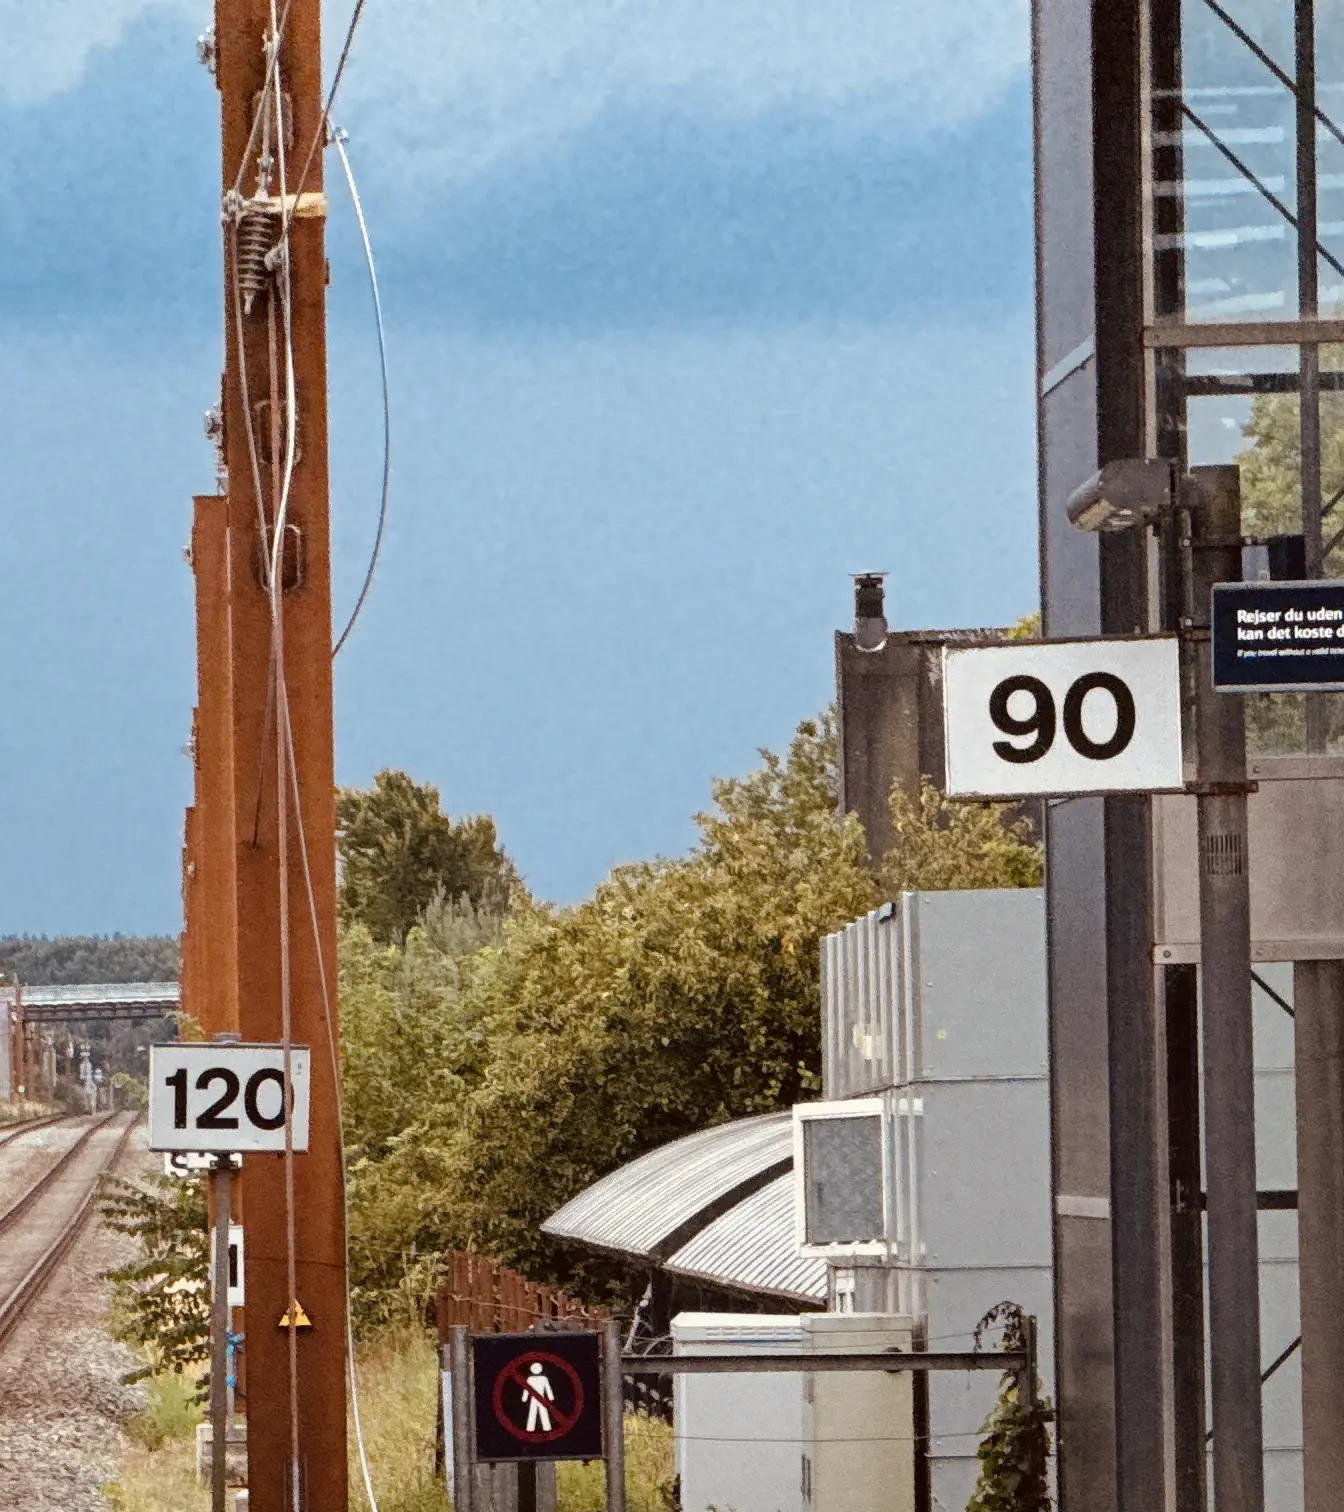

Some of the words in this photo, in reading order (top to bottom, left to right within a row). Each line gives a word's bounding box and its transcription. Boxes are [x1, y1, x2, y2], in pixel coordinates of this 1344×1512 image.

[1237, 609, 1282, 625] Rejser
[1284, 608, 1304, 621] du
[1307, 607, 1343, 621] uden
[1237, 627, 1264, 640] kan
[1267, 626, 1291, 639] det
[1294, 625, 1333, 639] koste
[989, 671, 1135, 763] 90
[165, 1067, 295, 1130] 120
